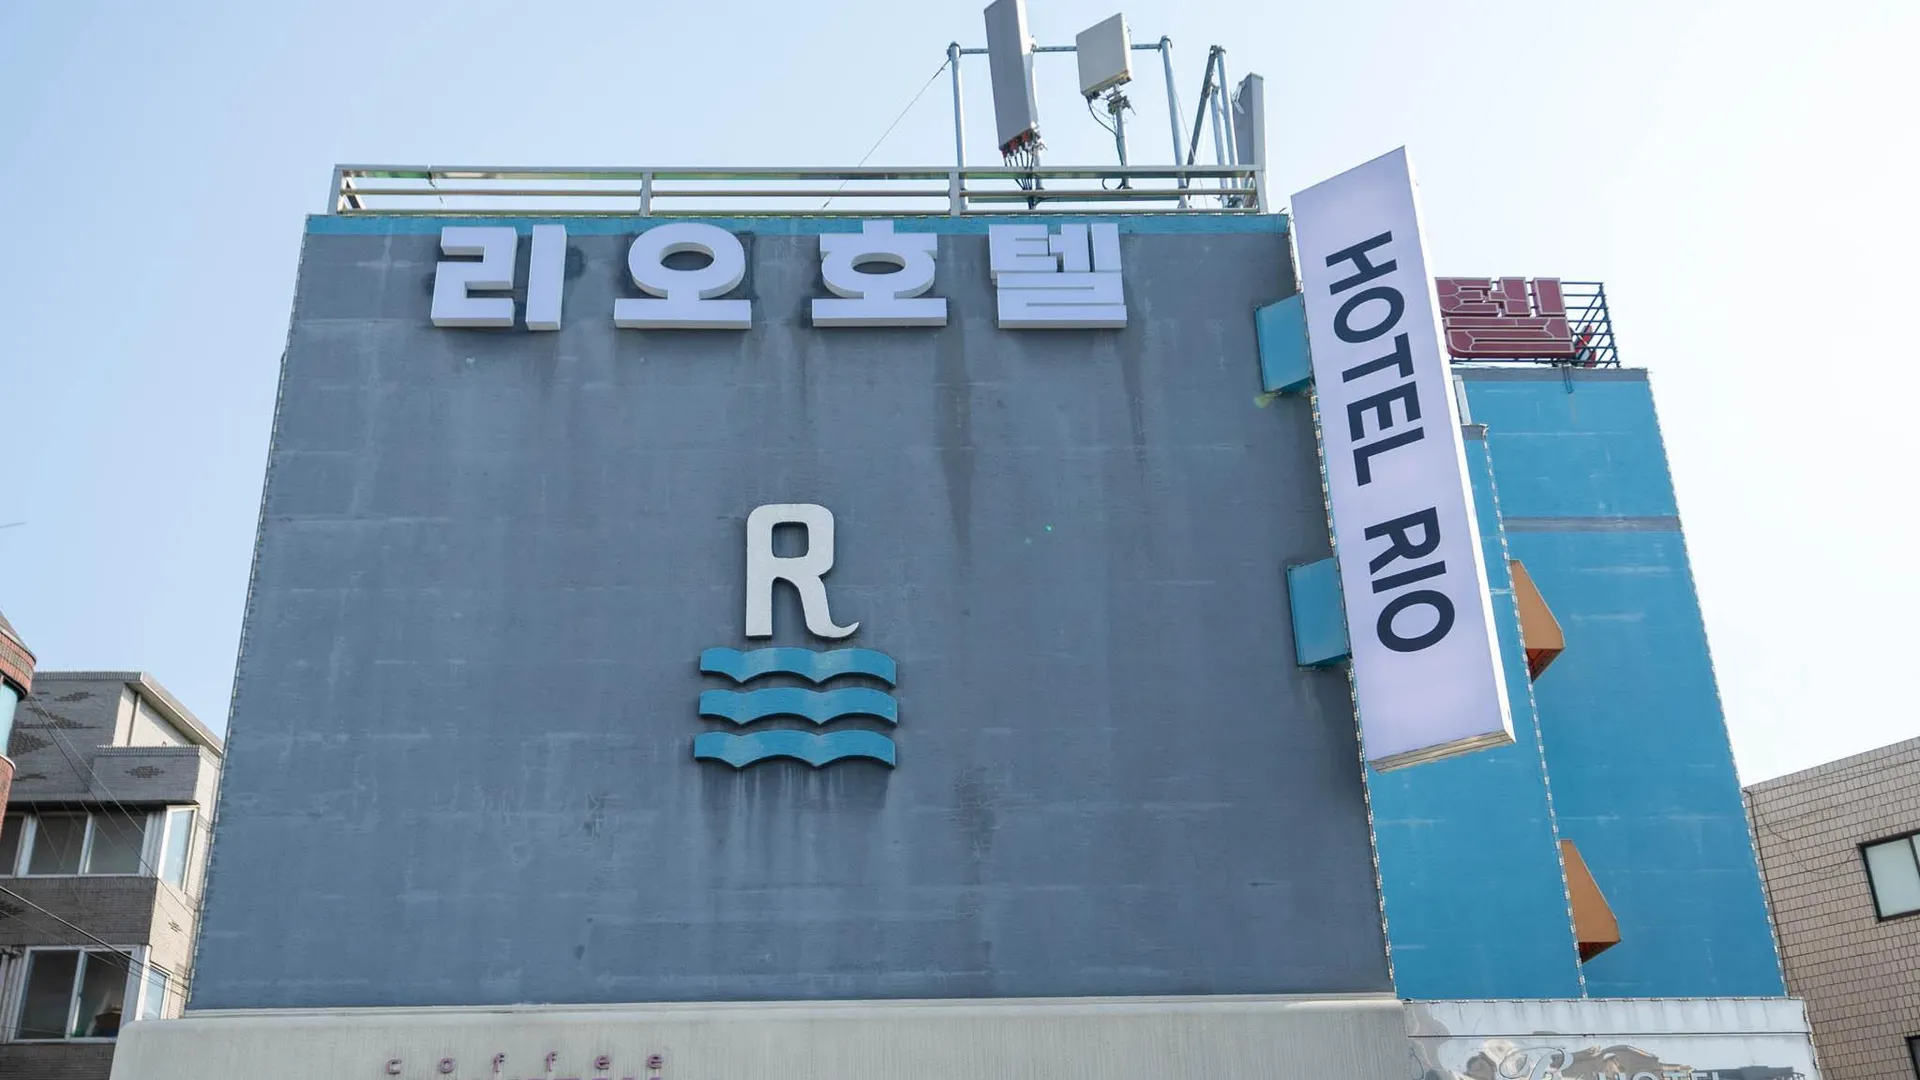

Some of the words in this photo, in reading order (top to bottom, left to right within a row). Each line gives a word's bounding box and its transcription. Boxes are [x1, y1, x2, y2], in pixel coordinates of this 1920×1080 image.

[430, 220, 1128, 331] 리오호텔
[1325, 230, 1425, 487] HOTEL
[746, 503, 860, 639] R
[1364, 506, 1456, 653] RIO
[386, 1051, 664, 1076] coffee
